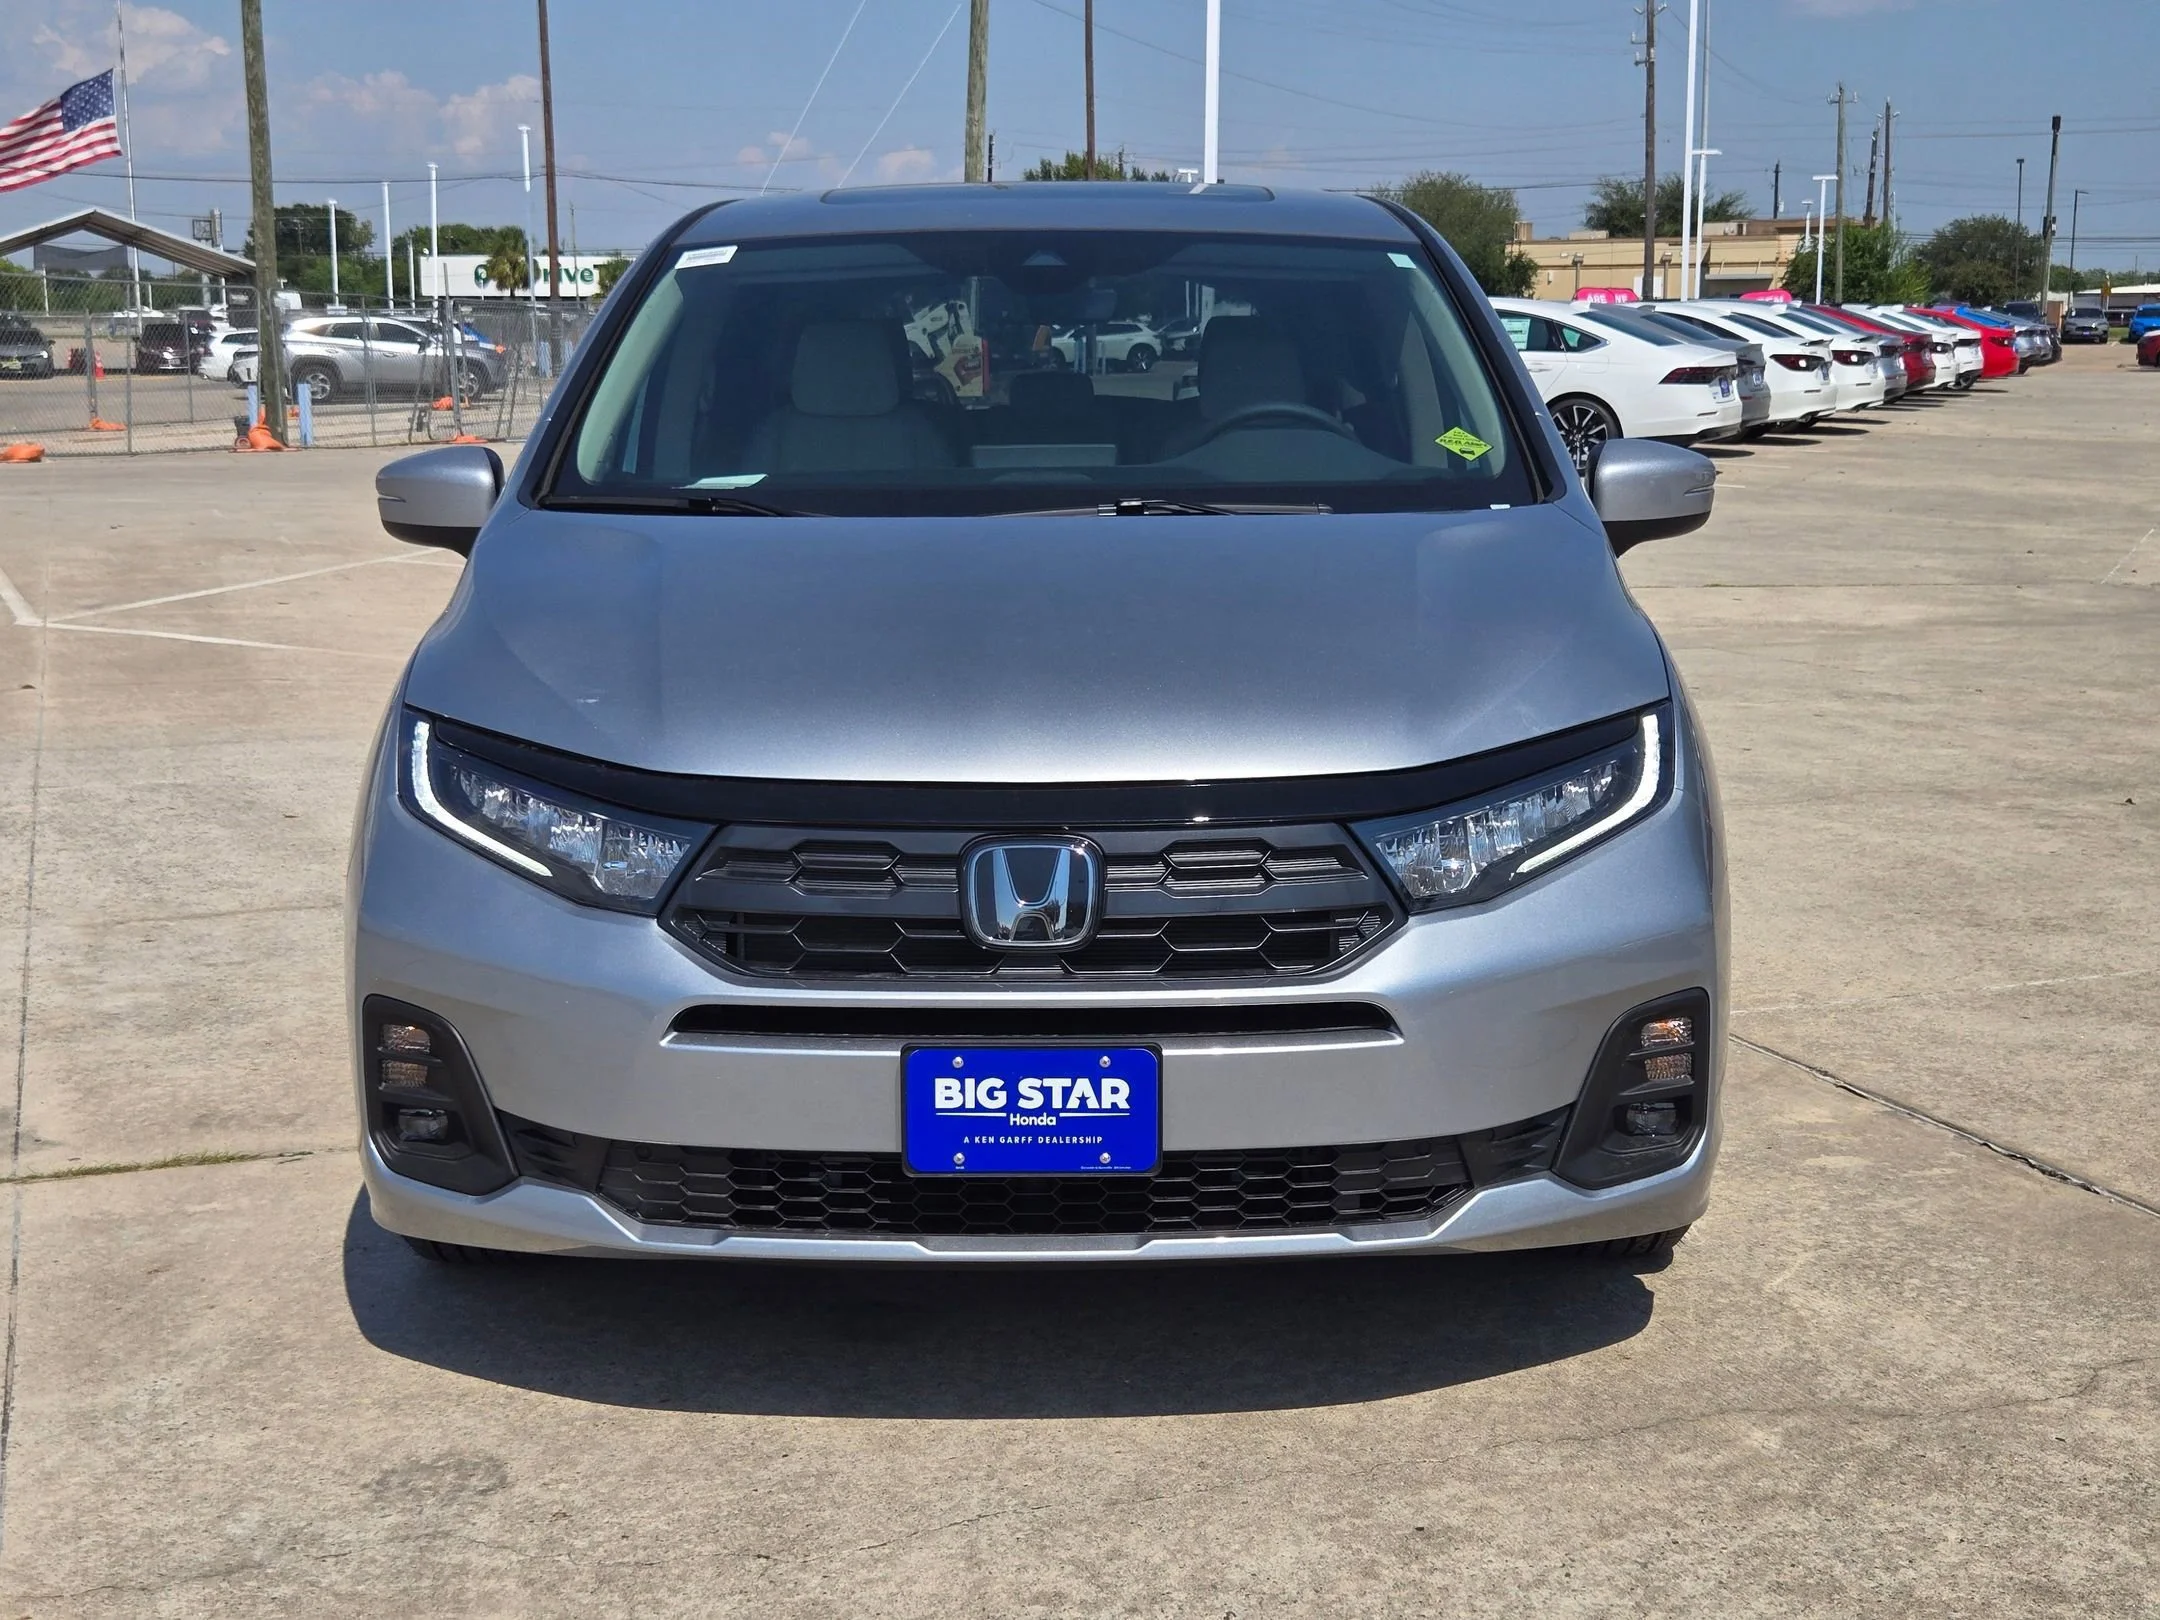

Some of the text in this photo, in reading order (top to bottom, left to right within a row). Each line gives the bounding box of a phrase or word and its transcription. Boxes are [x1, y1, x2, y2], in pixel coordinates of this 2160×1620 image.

[934, 1077, 1131, 1109] BIG STAR
[1009, 1112, 1057, 1126] Honda
[963, 1136, 1103, 1144] A KEN GARFF DEALERSHIP
